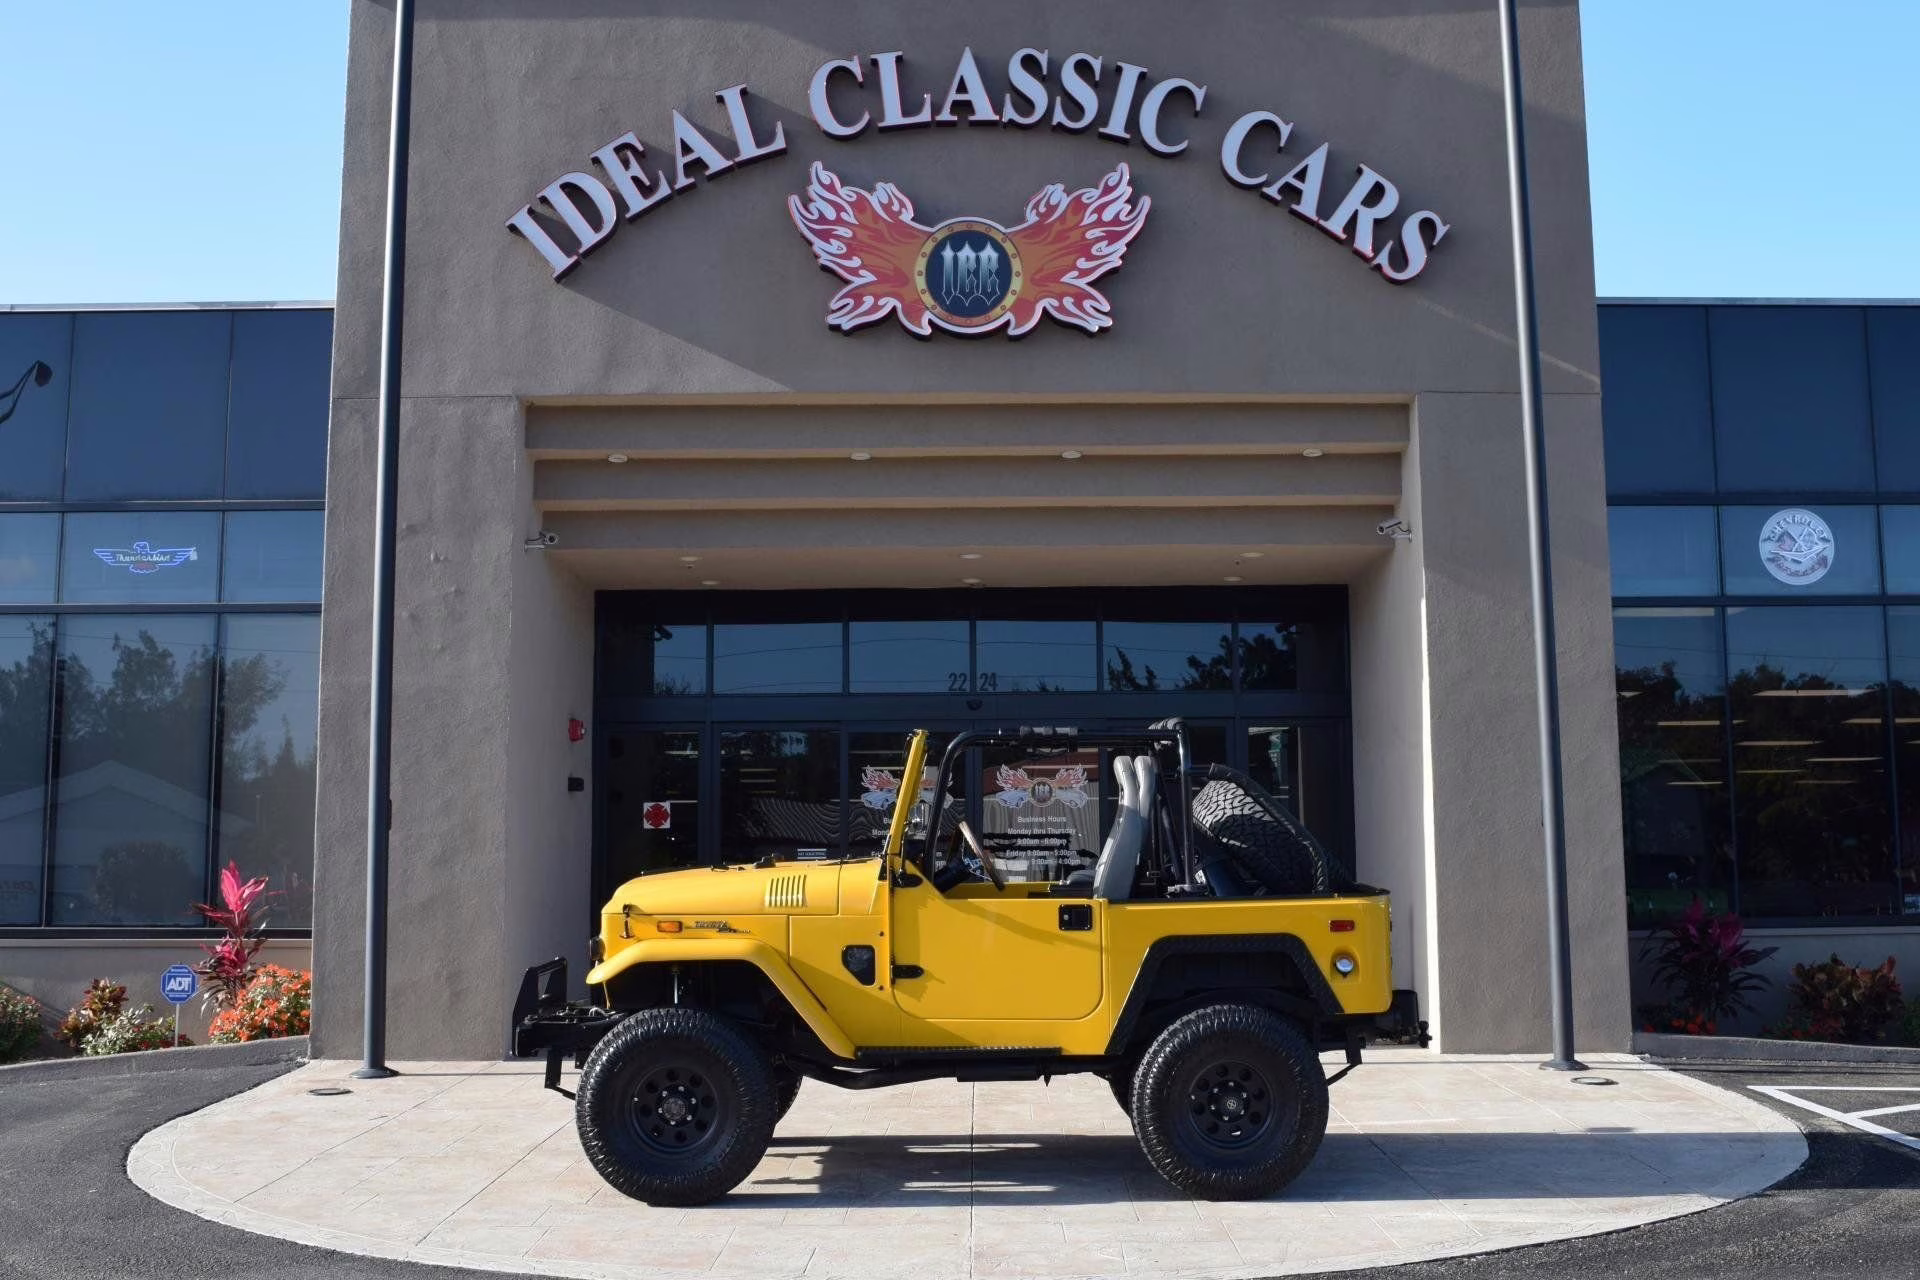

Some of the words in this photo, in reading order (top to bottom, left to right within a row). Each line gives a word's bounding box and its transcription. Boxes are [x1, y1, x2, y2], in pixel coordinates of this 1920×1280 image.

[505, 83, 787, 283] IDEAL
[808, 46, 1207, 157] CLASSIC
[1220, 110, 1450, 285] CARS
[1017, 815, 1046, 823] Business
[1007, 827, 1032, 836] Monday
[1048, 827, 1076, 836] Thursday
[1006, 849, 1026, 858] Friday
[166, 977, 192, 991] ADT
